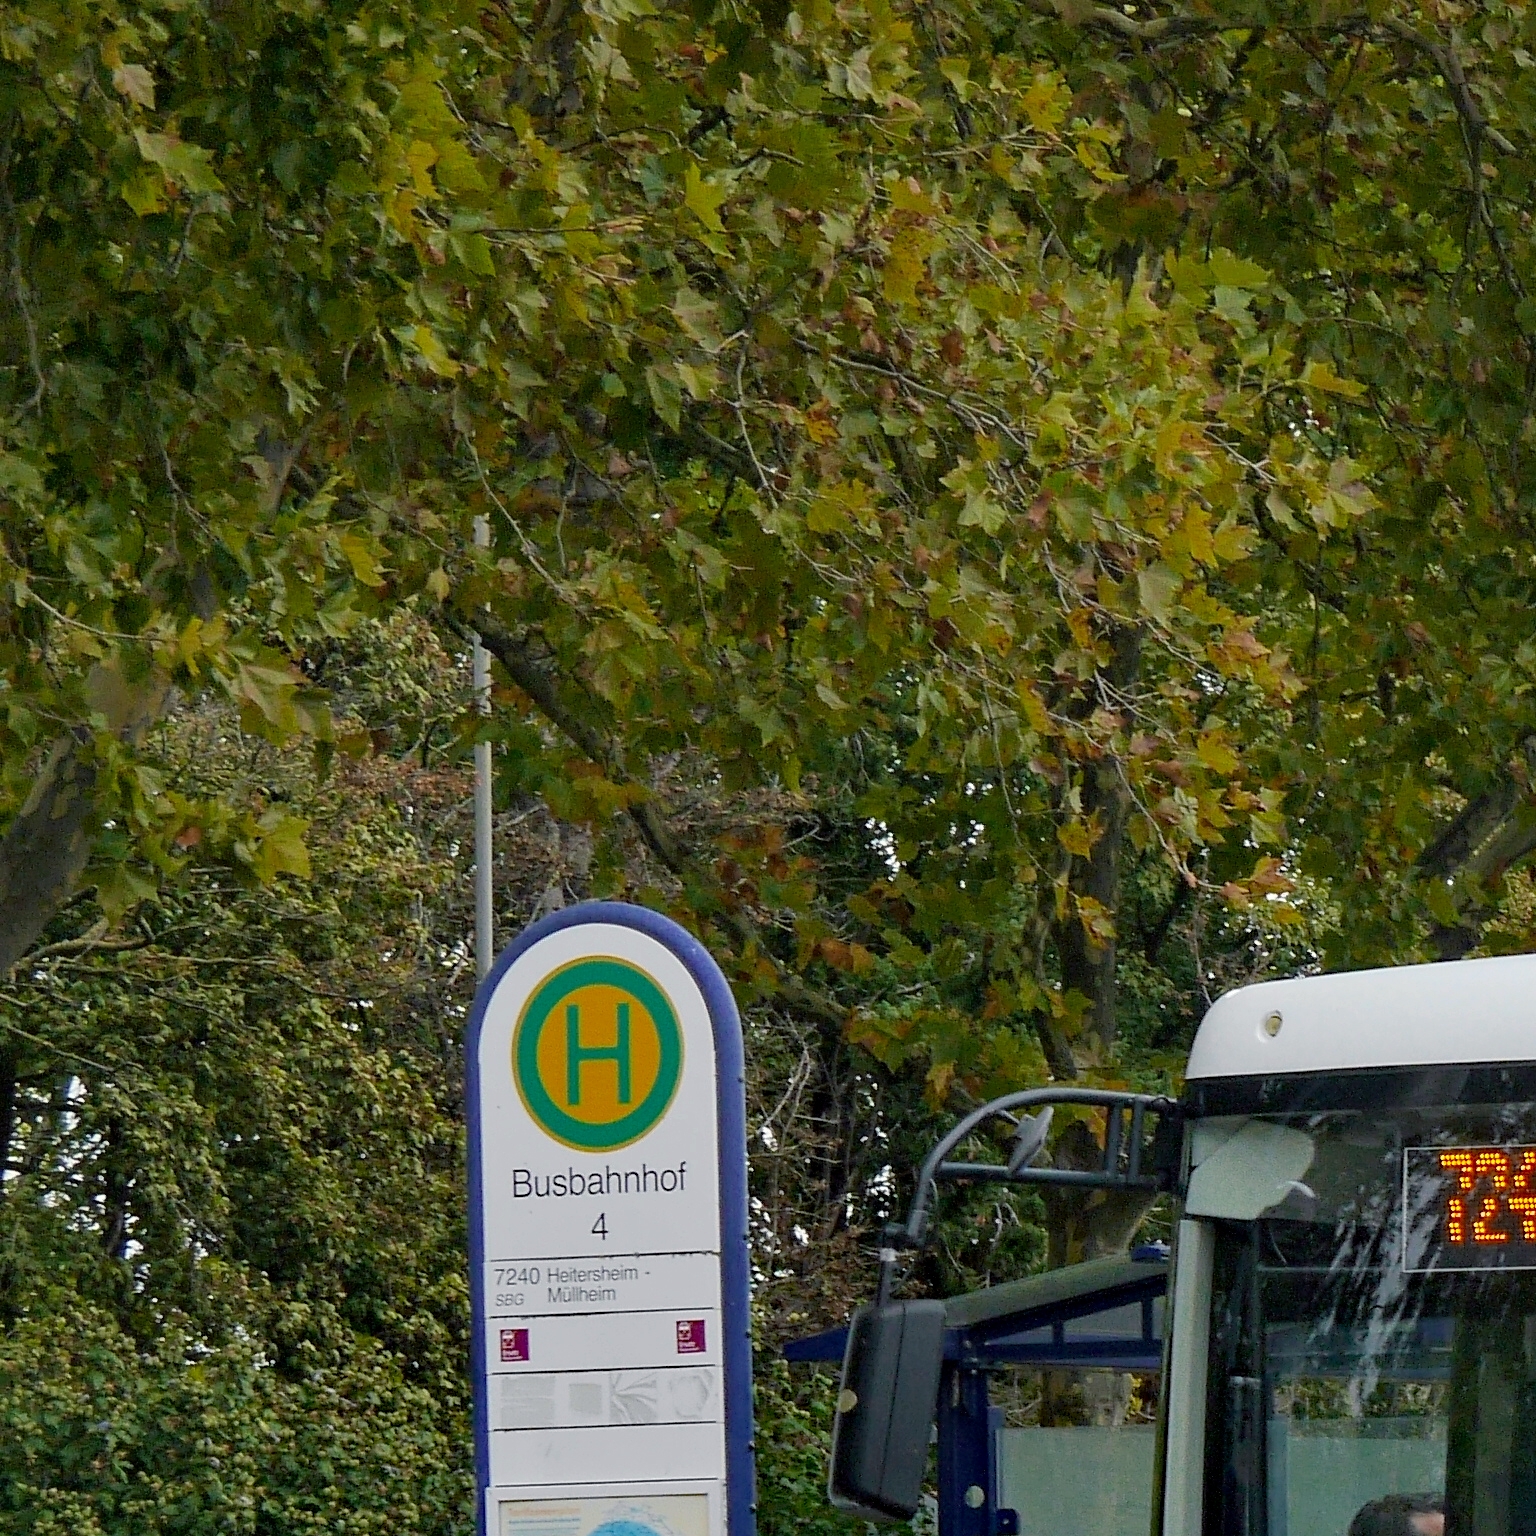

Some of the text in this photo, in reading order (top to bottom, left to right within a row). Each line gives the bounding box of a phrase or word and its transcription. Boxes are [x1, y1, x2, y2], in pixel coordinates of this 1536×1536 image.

[565, 1002, 631, 1106] H
[512, 1161, 687, 1198] Busbahnhof
[590, 1212, 609, 1241] 4
[493, 1267, 541, 1286] 7240
[547, 1264, 639, 1284] Heitersheim
[495, 1286, 617, 1307] SBG Müllheim
